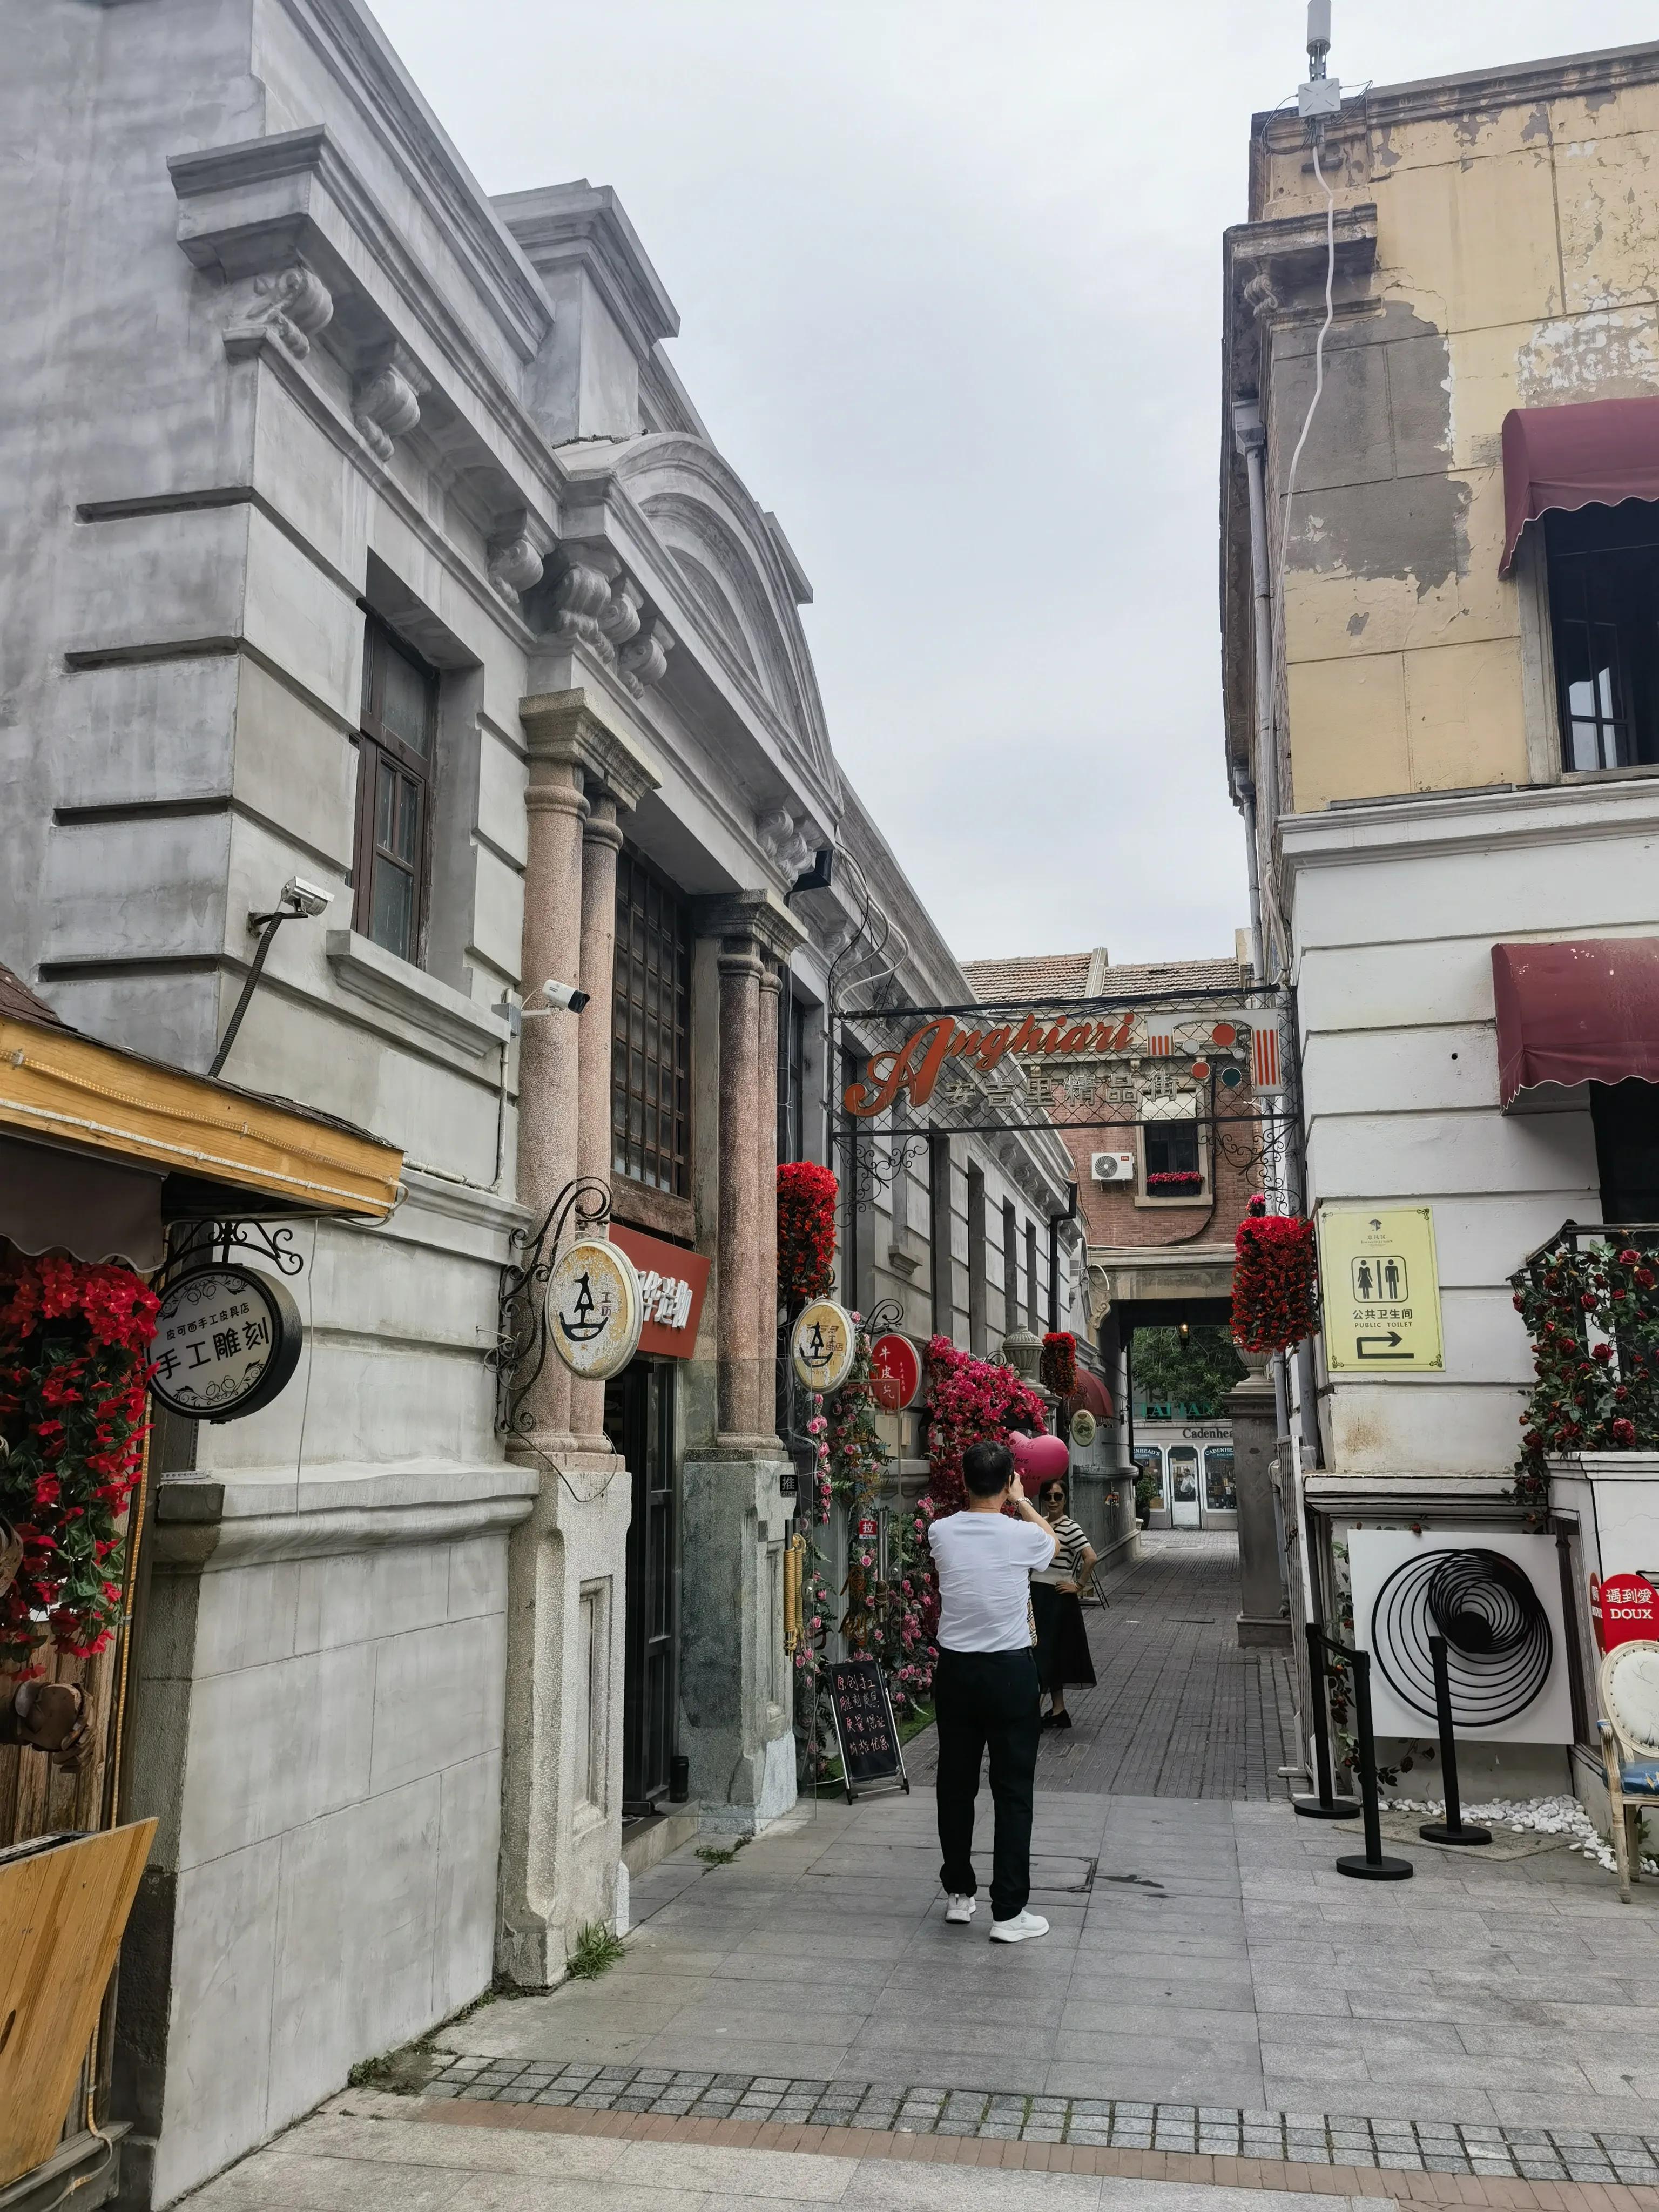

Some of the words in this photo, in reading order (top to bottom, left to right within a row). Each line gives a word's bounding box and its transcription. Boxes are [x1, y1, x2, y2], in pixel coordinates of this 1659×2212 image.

[844, 1013, 1135, 1118] Anghiari
[945, 1069, 1179, 1110] 安吉里精品街
[166, 1302, 250, 1341] 皮可西手工皮具店
[1352, 1308, 1413, 1320] 公共卫生间
[156, 1316, 269, 1380] 手工雕刻
[781, 1476, 795, 1491] 推
[862, 1522, 873, 1533] 拉
[1606, 1588, 1654, 1604] 遇到愛
[1610, 1608, 1654, 1620] DOUX
[837, 1673, 876, 1691] 原创手工
[849, 1734, 890, 1756] 价格优惠
